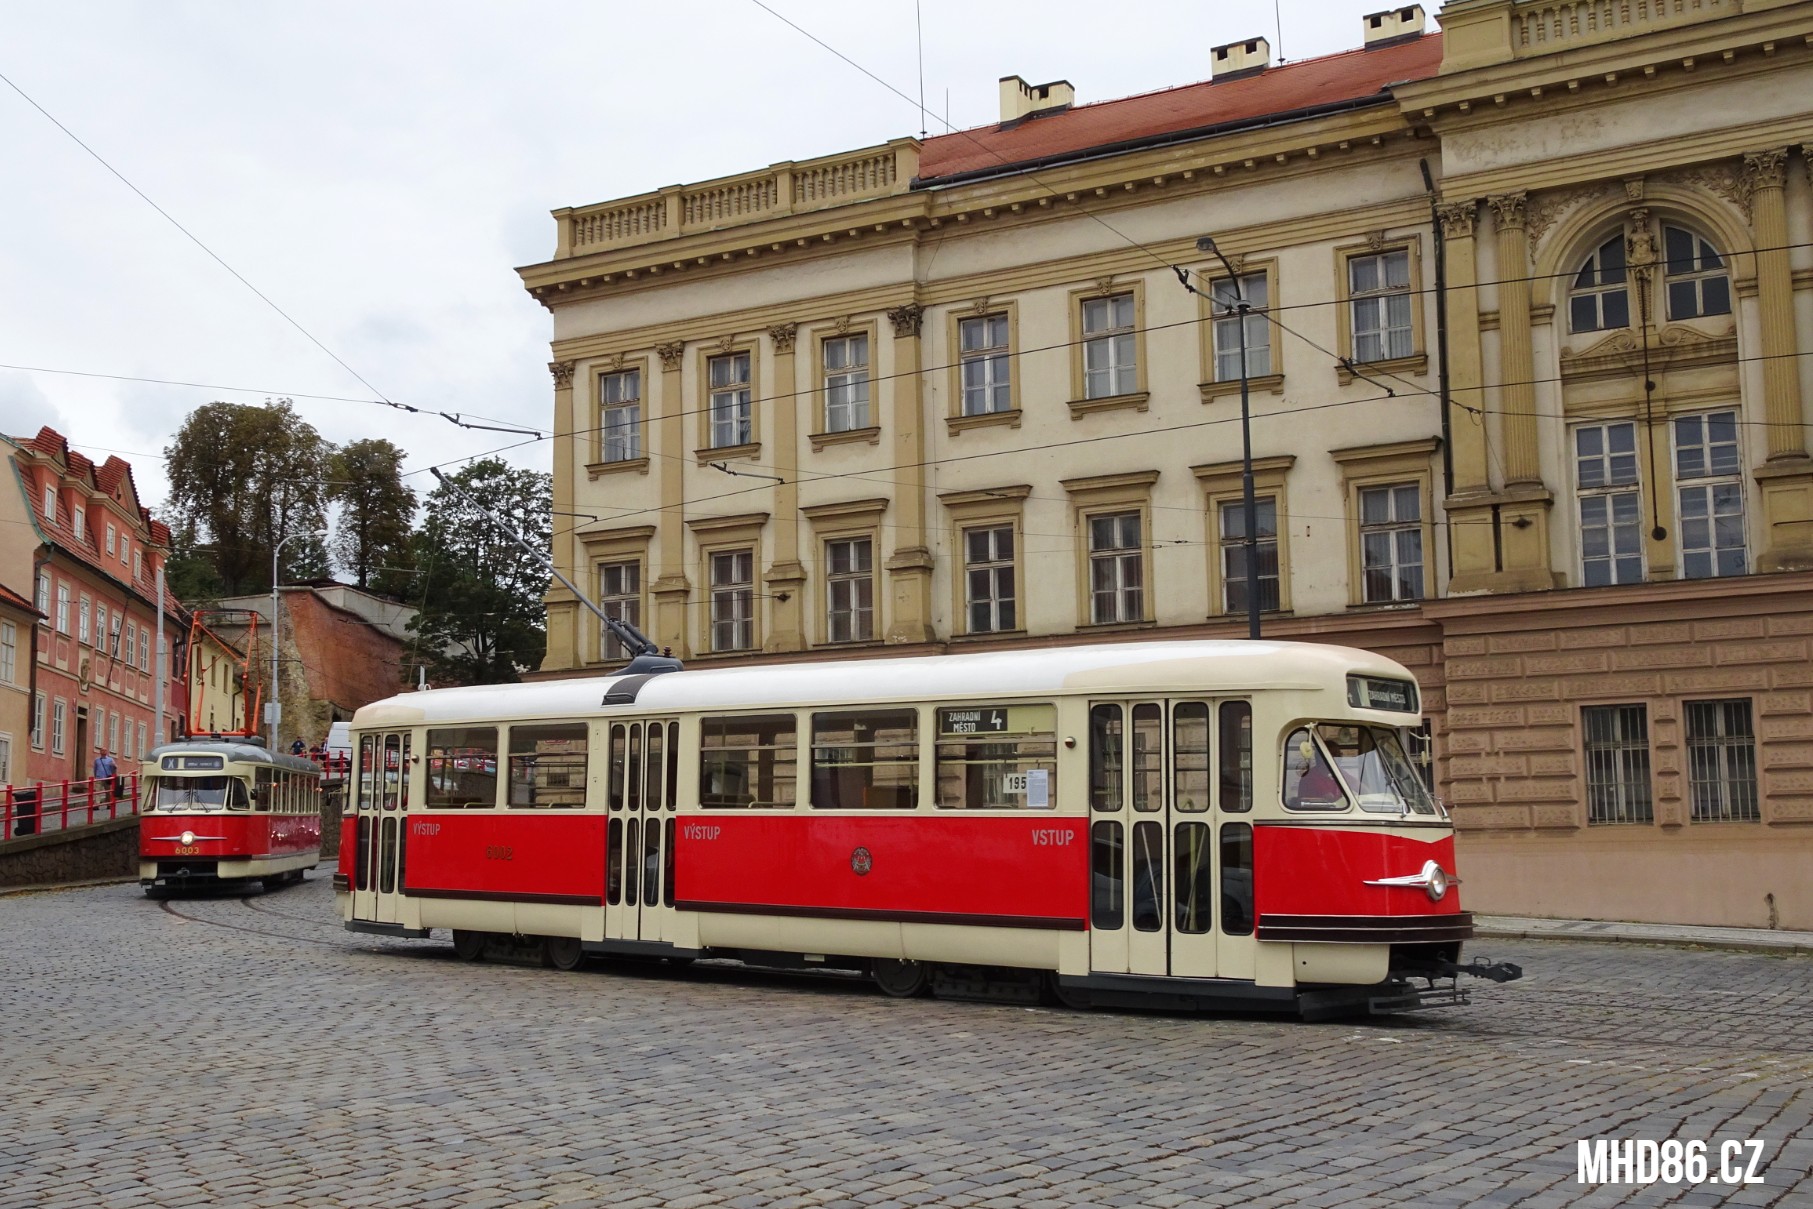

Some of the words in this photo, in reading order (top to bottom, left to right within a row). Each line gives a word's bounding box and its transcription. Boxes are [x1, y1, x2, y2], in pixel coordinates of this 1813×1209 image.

[953, 721, 976, 733] MĚSTO
[990, 710, 1003, 730] 4
[413, 821, 441, 836] VÝSTUP
[684, 823, 721, 840] VÝSTUP
[1031, 829, 1075, 846] VSTUP
[175, 847, 200, 855] 6003
[486, 846, 513, 861] 6002
